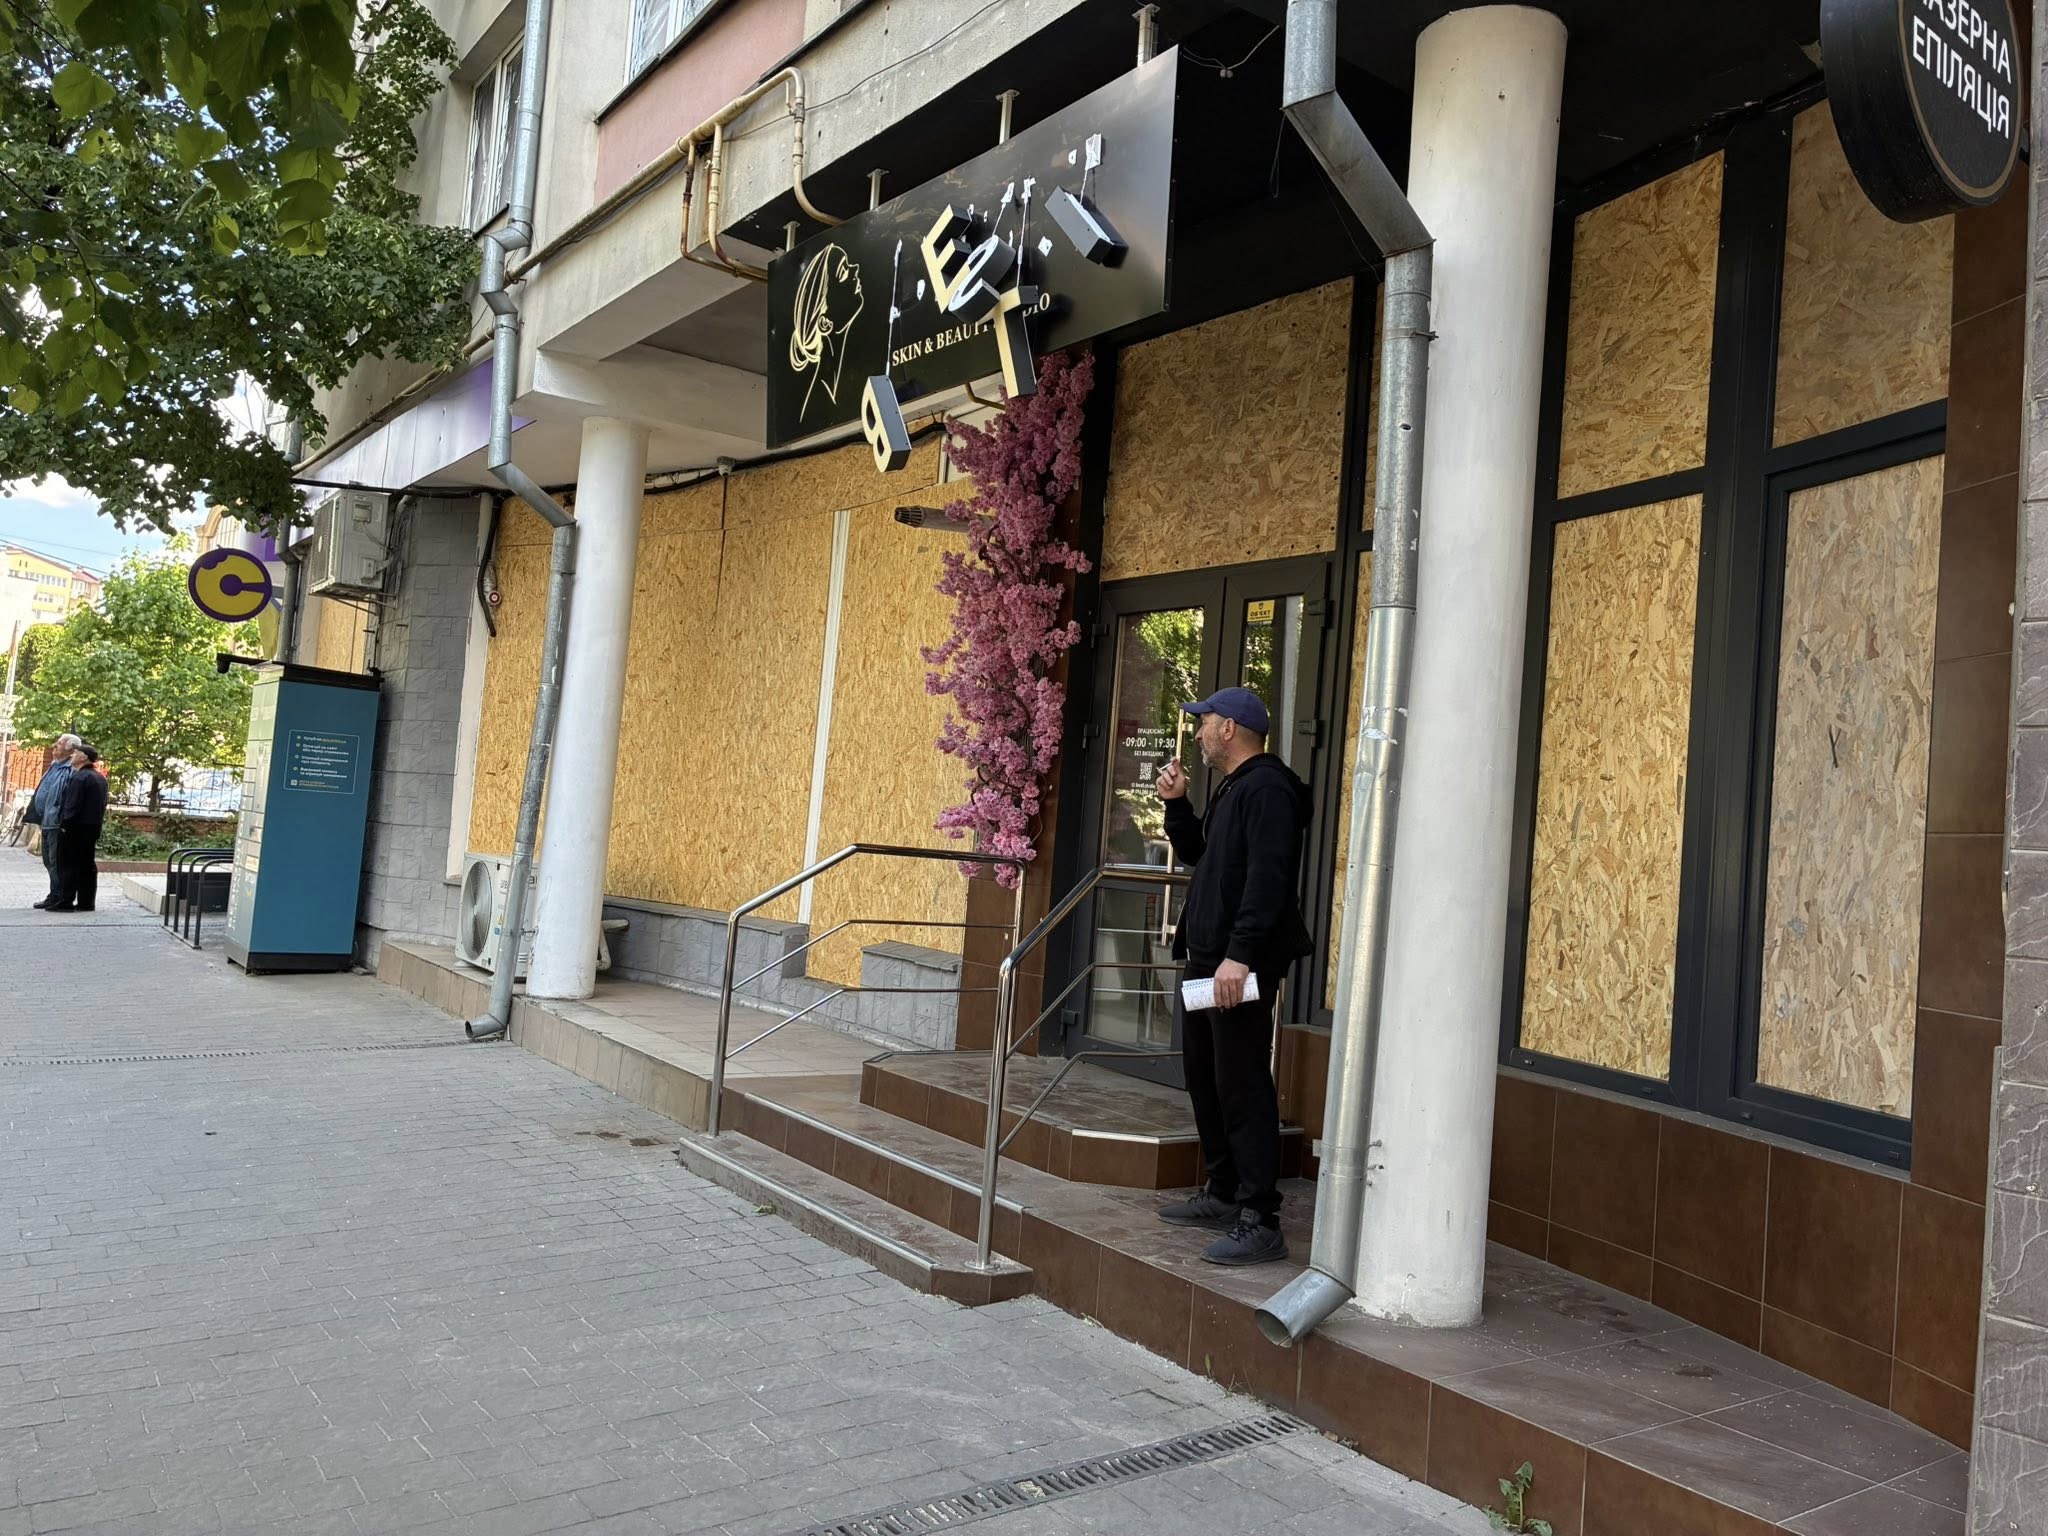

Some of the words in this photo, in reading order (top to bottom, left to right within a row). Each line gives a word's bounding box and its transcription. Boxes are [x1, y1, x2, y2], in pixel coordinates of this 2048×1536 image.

[1912, 15, 2010, 139] ЕПІЛЯЦІЯ
[1923, 0, 2011, 85] ЗЕРНА
[891, 341, 923, 367] SKIN
[924, 337, 935, 355] &
[936, 320, 988, 350] BEAUT
